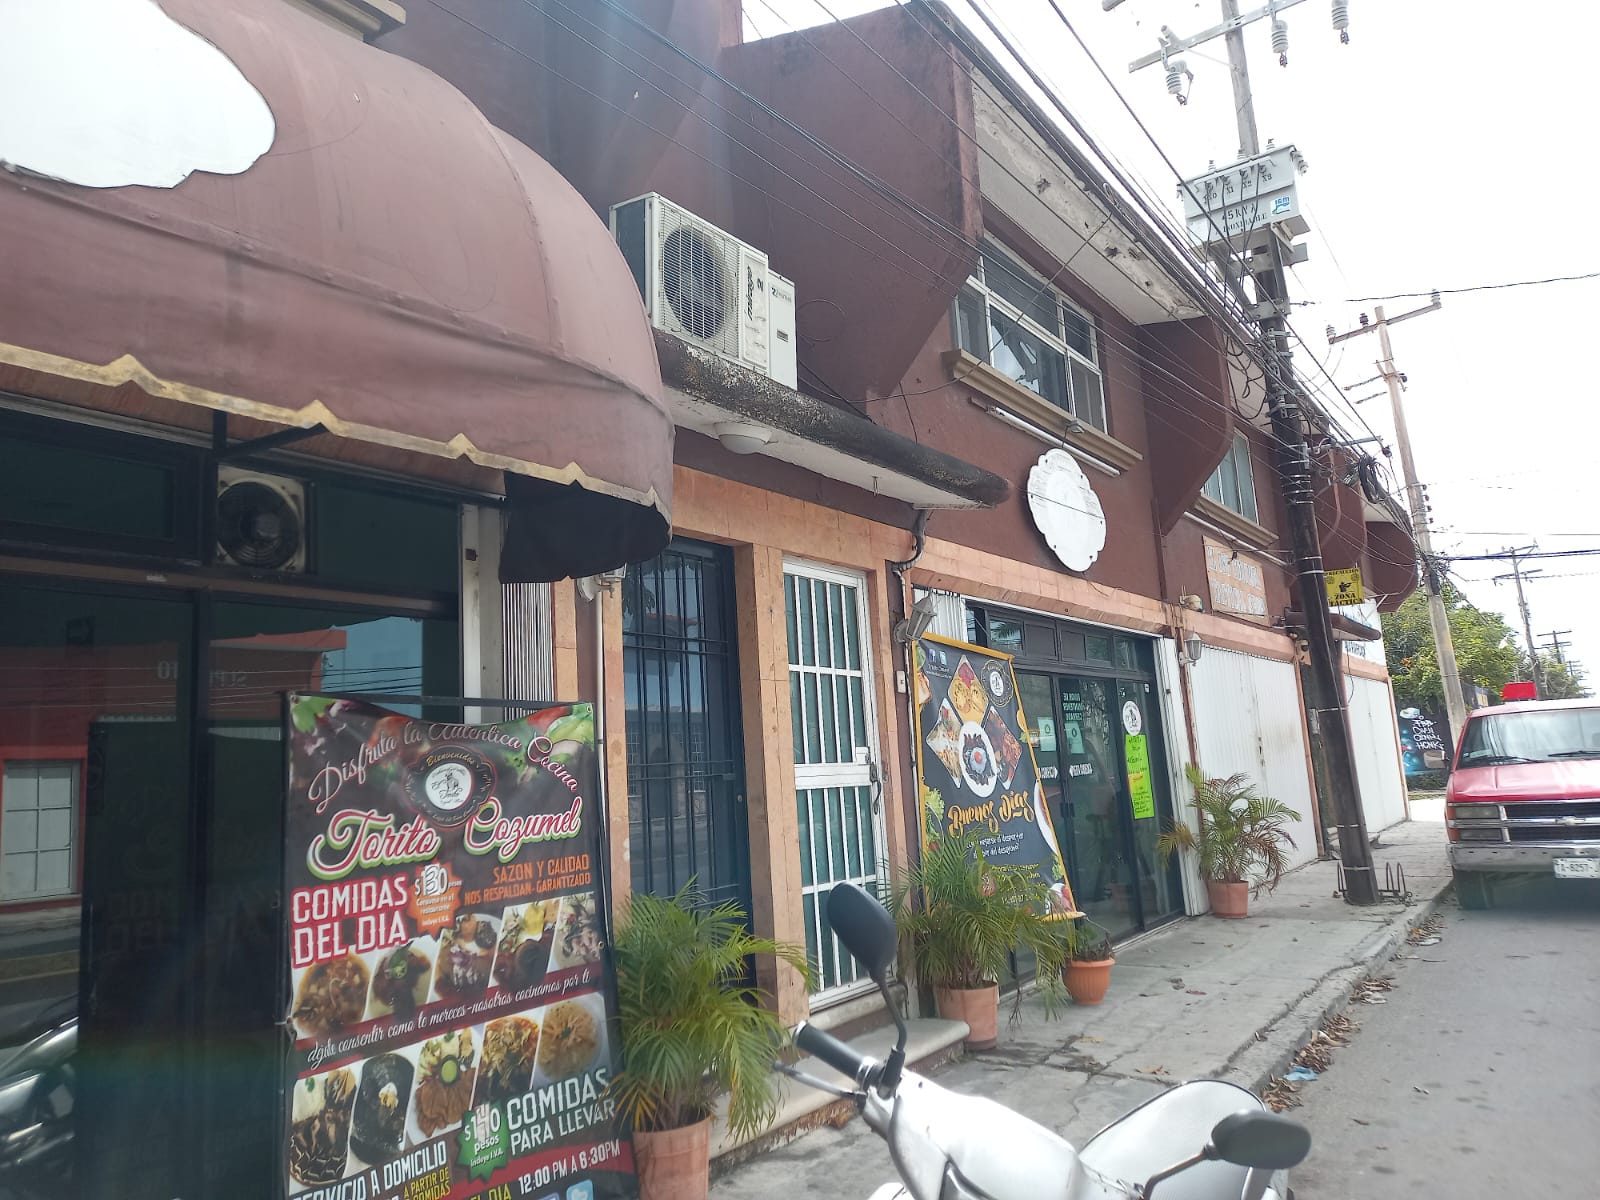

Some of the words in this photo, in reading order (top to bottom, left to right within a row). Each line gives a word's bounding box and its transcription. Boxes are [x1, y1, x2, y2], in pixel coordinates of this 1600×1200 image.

[1334, 592, 1356, 600] ZONA
[308, 733, 397, 814] Disfruta
[404, 721, 421, 745] la
[428, 723, 522, 749] Autentica
[527, 732, 578, 793] Cocina
[426, 752, 475, 767] Bienvenidos
[307, 808, 442, 879] Torito
[464, 796, 583, 863] Cozumel
[947, 801, 999, 840] Buenos
[464, 890, 480, 905] NOS
[536, 872, 592, 893] GARANTIZADO
[493, 863, 533, 884] SAZON
[536, 860, 544, 877] Y
[547, 854, 590, 876] CALIDAD
[293, 876, 407, 924] COMIDAS
[293, 918, 346, 965] DEL
[356, 912, 409, 953] DIA
[338, 1024, 385, 1053] consentir
[387, 1020, 414, 1038] como
[418, 1011, 427, 1029] te
[515, 980, 562, 1002] cocinamos
[562, 973, 580, 995] por
[582, 967, 591, 984] ti
[506, 1068, 612, 1131] COMIDAS
[474, 1134, 500, 1156] pesos
[511, 1120, 554, 1156] PARA
[558, 1100, 615, 1137] LLEVAR
[370, 1169, 381, 1197] A
[383, 1140, 447, 1190] DOMICILIO
[403, 1186, 409, 1199] A
[411, 1173, 437, 1195] PARTIR
[440, 1166, 449, 1182] DE
[518, 1166, 551, 1195] 12:00
[552, 1158, 568, 1181] PM
[571, 1155, 578, 1174] A
